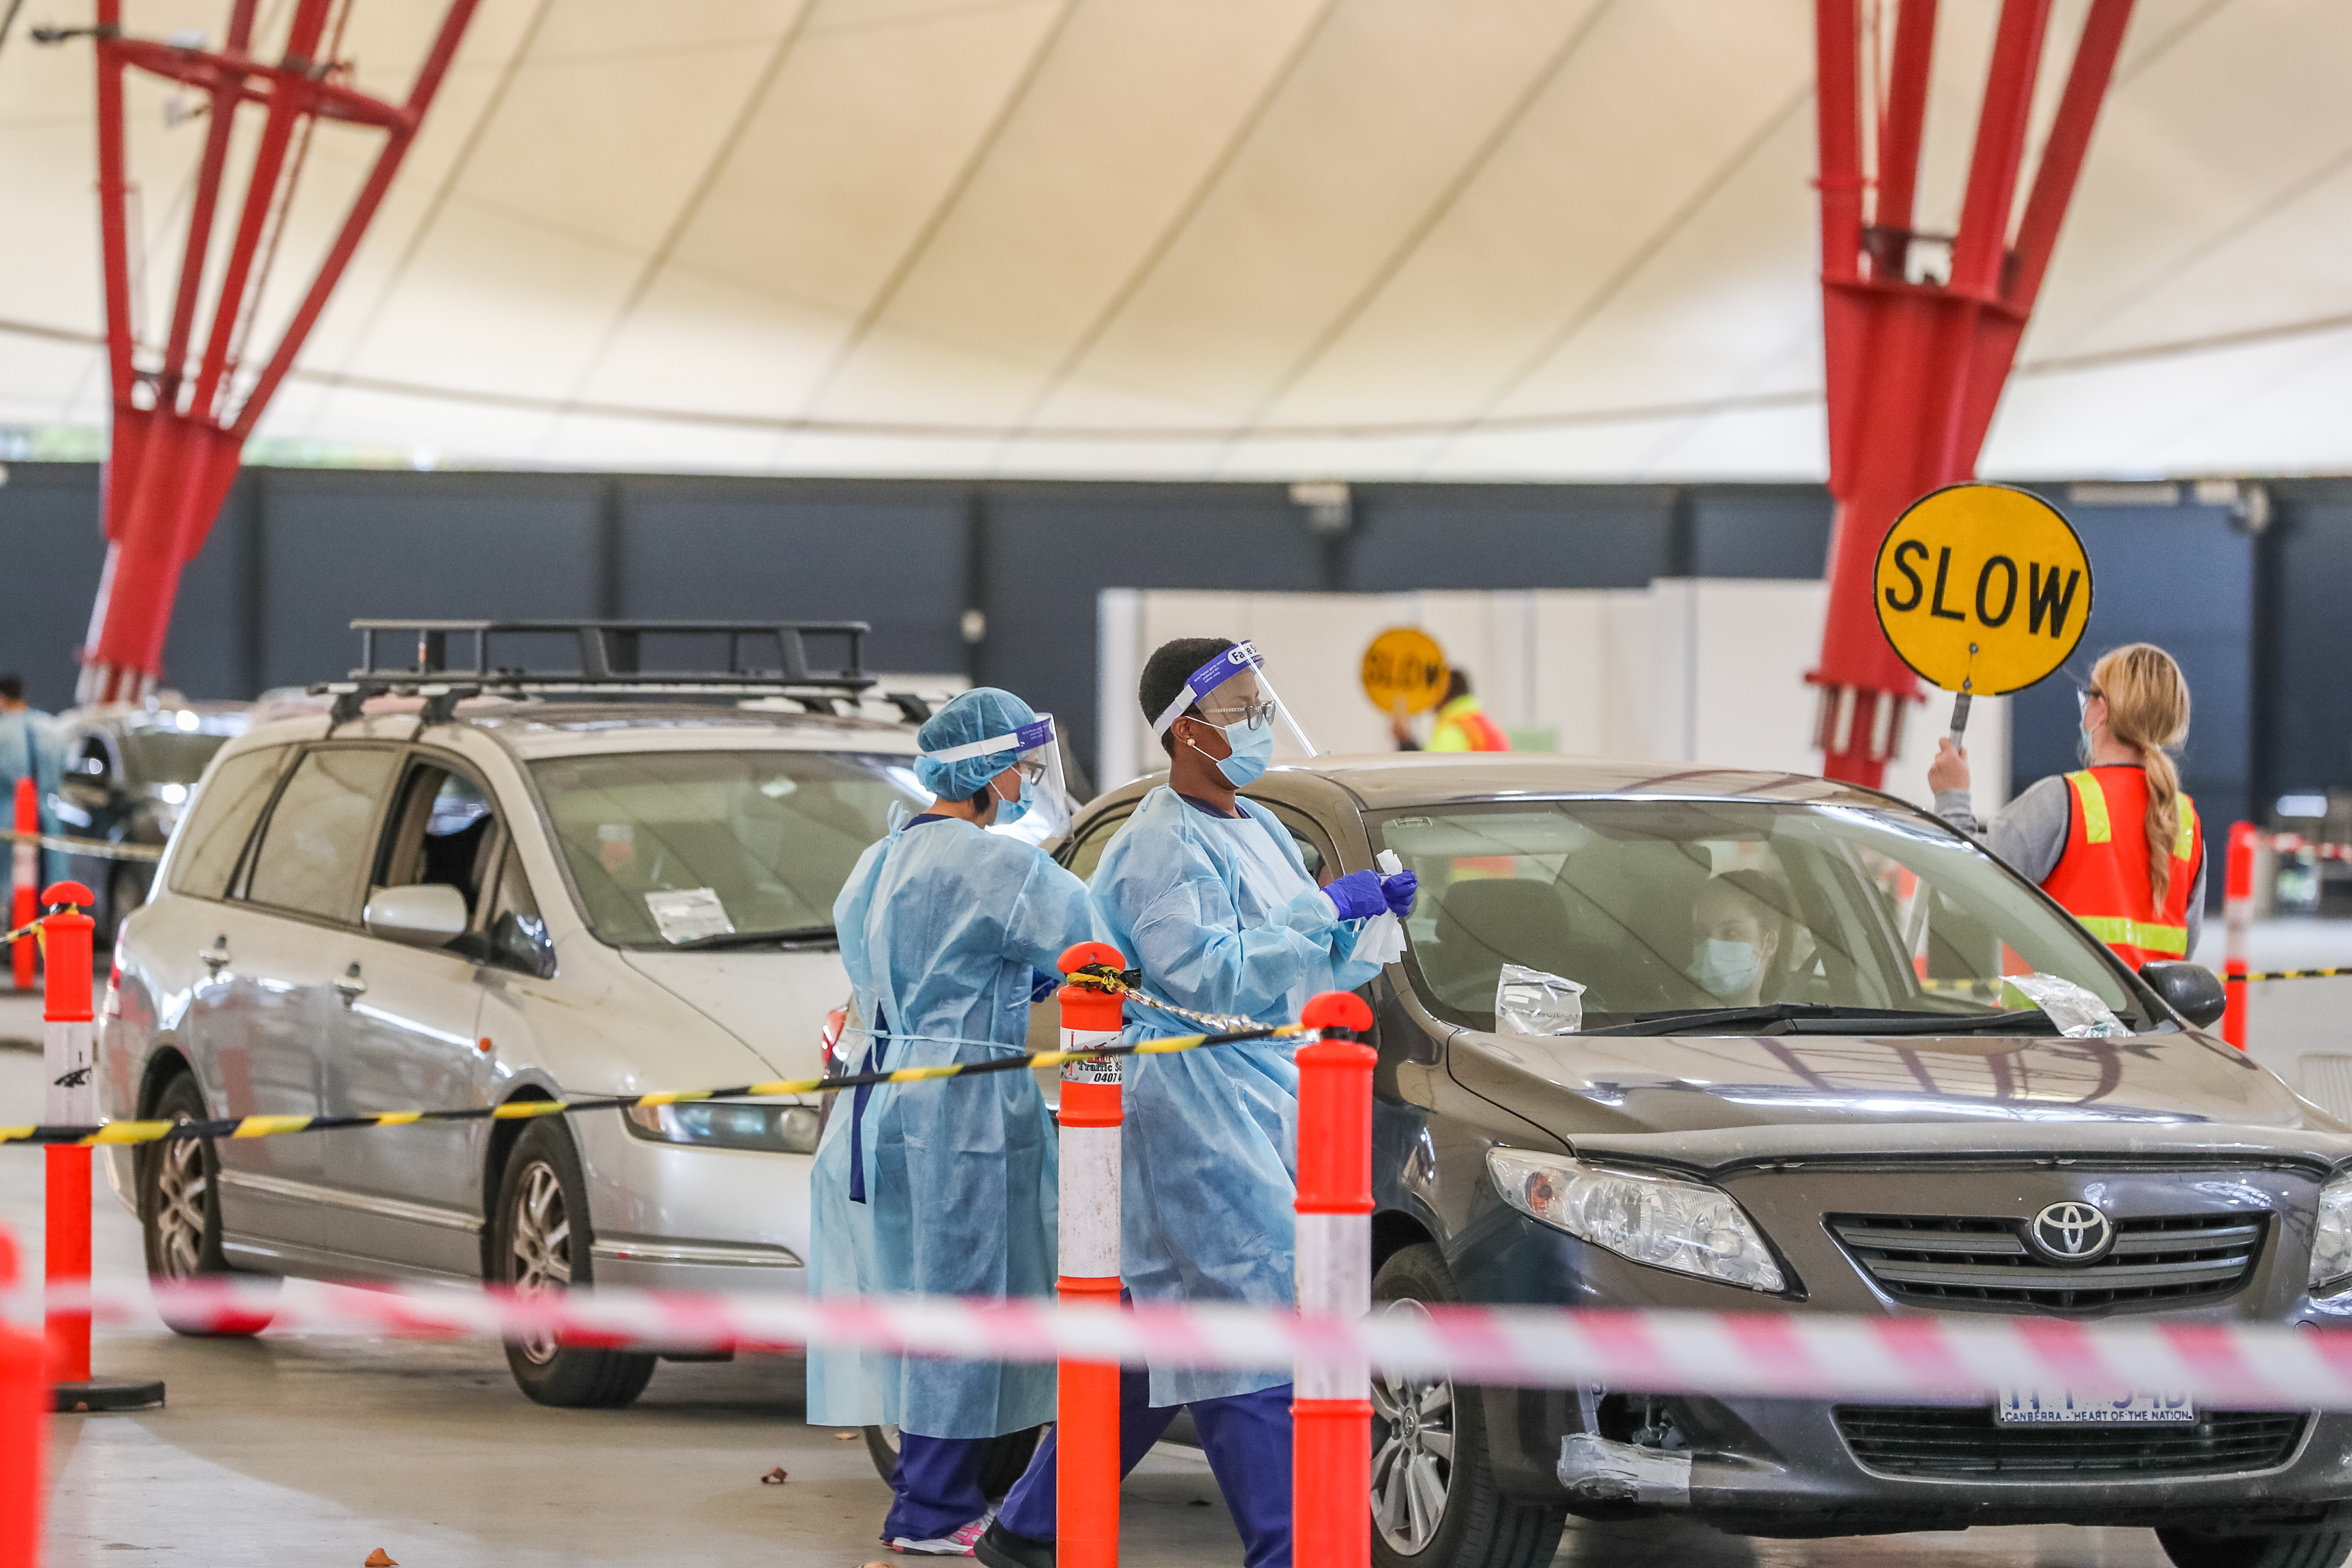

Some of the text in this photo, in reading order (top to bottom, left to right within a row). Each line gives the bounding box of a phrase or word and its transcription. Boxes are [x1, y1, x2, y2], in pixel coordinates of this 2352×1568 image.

[1885, 540, 2081, 640] SLOW
[1231, 648, 1252, 661] Fae
[1077, 1062, 1112, 1072] Traffic
[1094, 1073, 1117, 1082] 0407
[2005, 1411, 2062, 1422] CANBERRA
[2074, 1411, 2108, 1421] HEART
[2111, 1411, 2125, 1420] OF
[2128, 1411, 2148, 1420] THE
[2152, 1411, 2189, 1420] NATION
